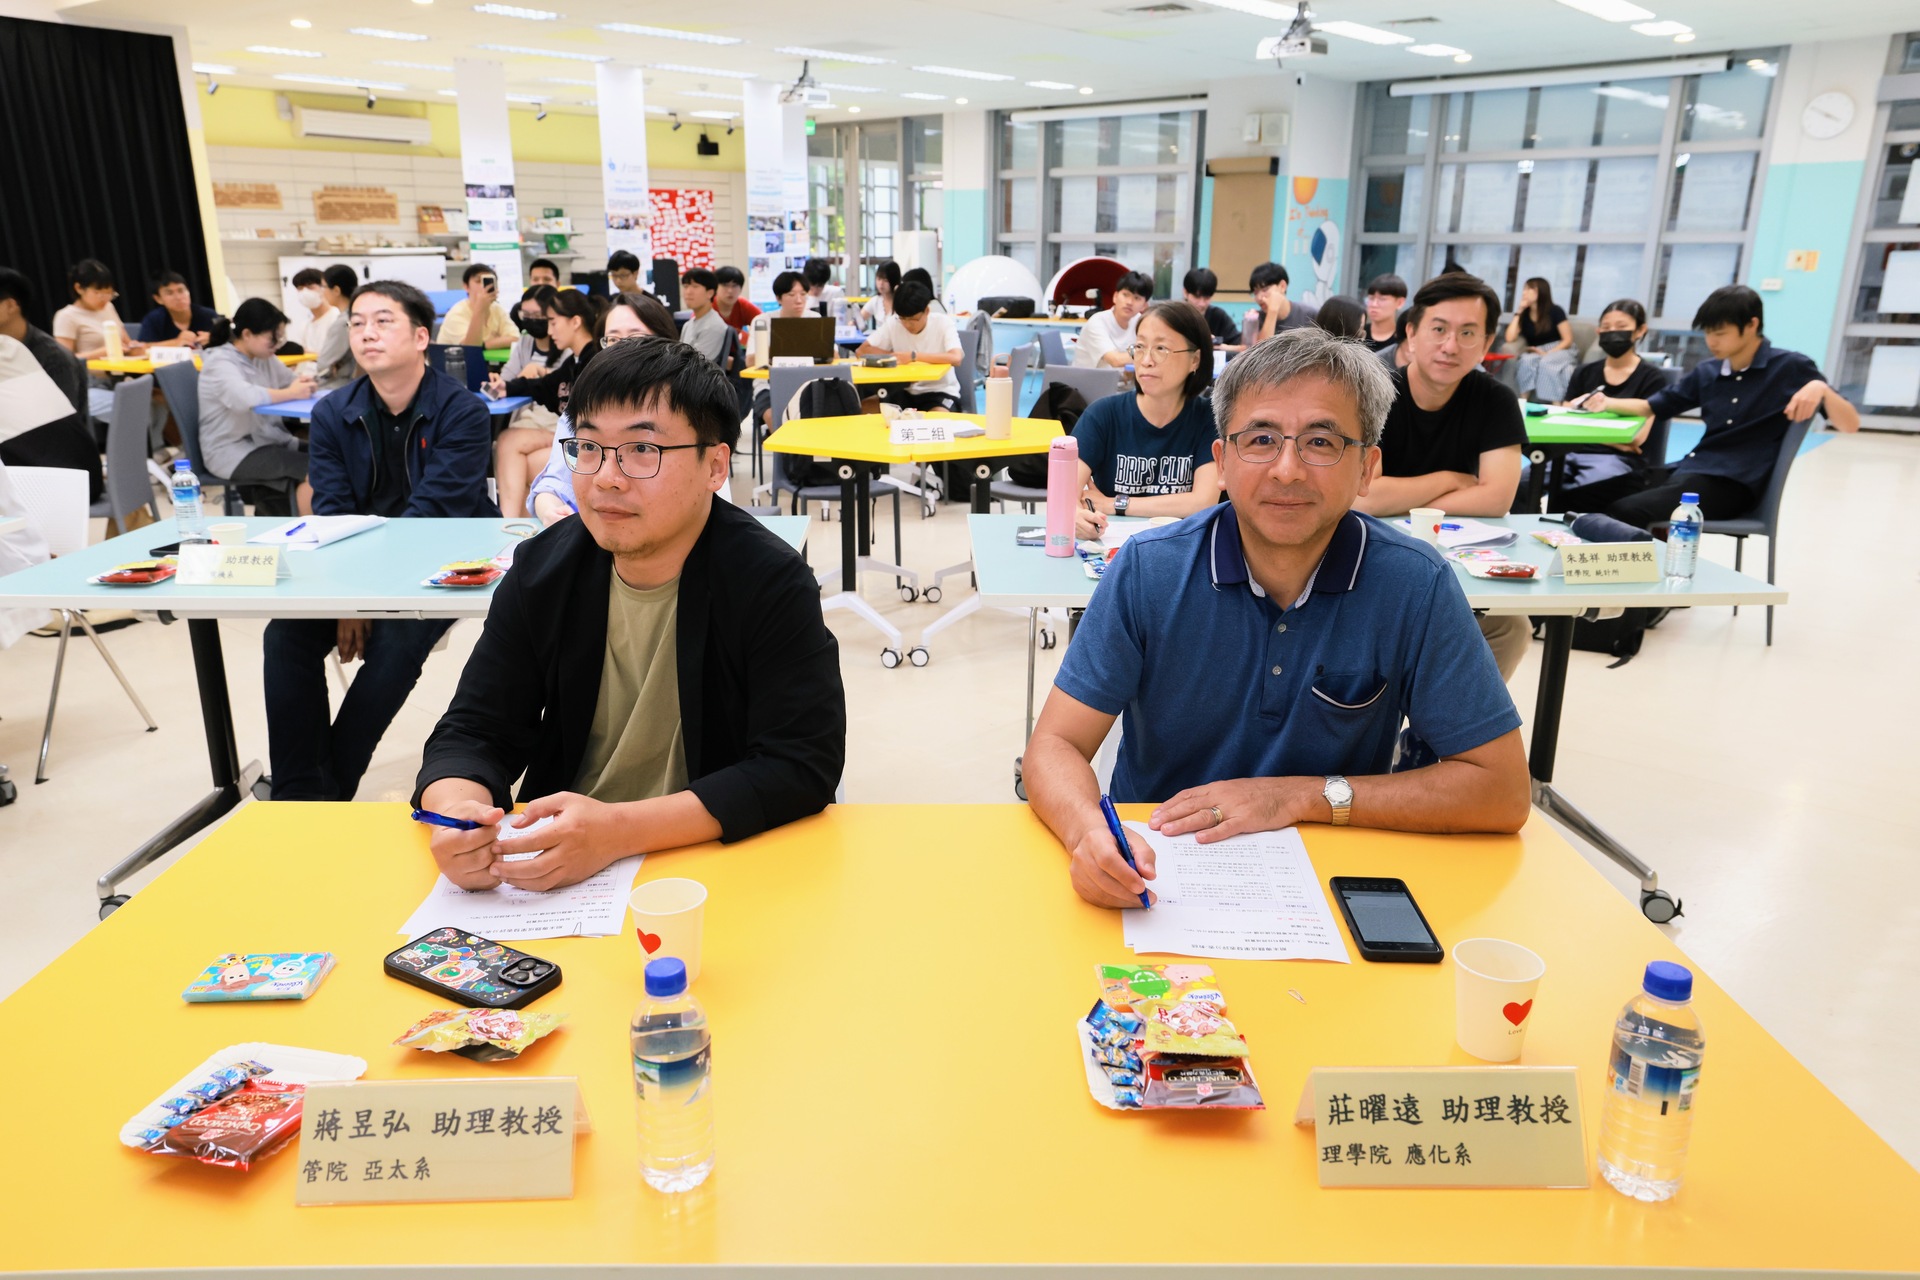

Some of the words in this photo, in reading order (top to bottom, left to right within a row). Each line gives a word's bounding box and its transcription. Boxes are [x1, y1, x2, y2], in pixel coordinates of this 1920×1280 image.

[901, 426, 946, 442] 第二組
[1114, 454, 1158, 486] BRPS
[1114, 485, 1160, 494] HEALTHY
[1160, 486, 1170, 494] &
[225, 554, 274, 566] 助理教授
[1566, 552, 1600, 564] 朱基祥
[1606, 551, 1654, 563] 助理教授
[1565, 569, 1591, 578] 理學院
[1327, 1092, 1422, 1126] 莊曜遠
[1441, 1093, 1573, 1127] 助理教授
[311, 1106, 411, 1142] 蔣昱弘
[431, 1104, 564, 1137] 助理教授
[1321, 1142, 1392, 1167] 理學院
[1404, 1141, 1473, 1167] 應化系
[301, 1159, 349, 1186] 管院
[362, 1157, 432, 1183] 亞太系
